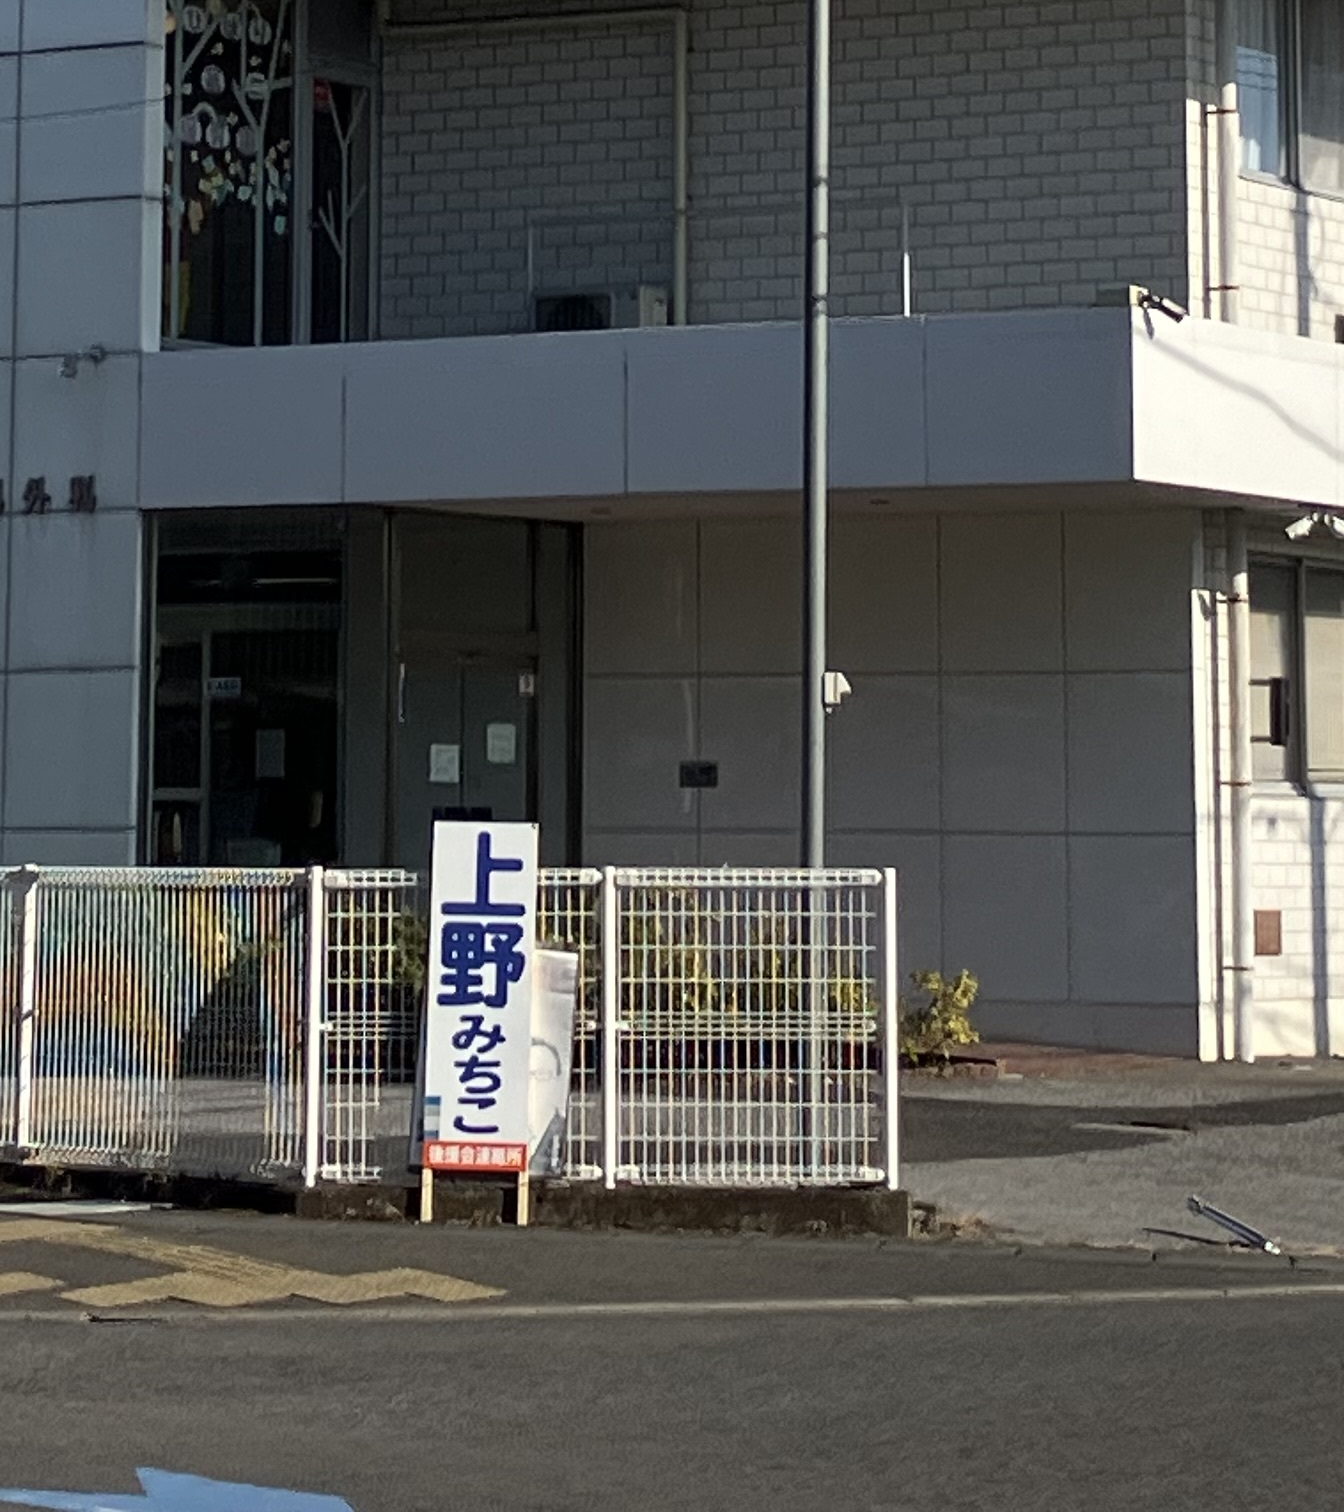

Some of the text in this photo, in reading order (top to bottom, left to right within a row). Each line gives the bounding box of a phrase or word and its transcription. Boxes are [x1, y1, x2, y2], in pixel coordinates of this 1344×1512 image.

[436, 831, 526, 1134] 上野みちこ
